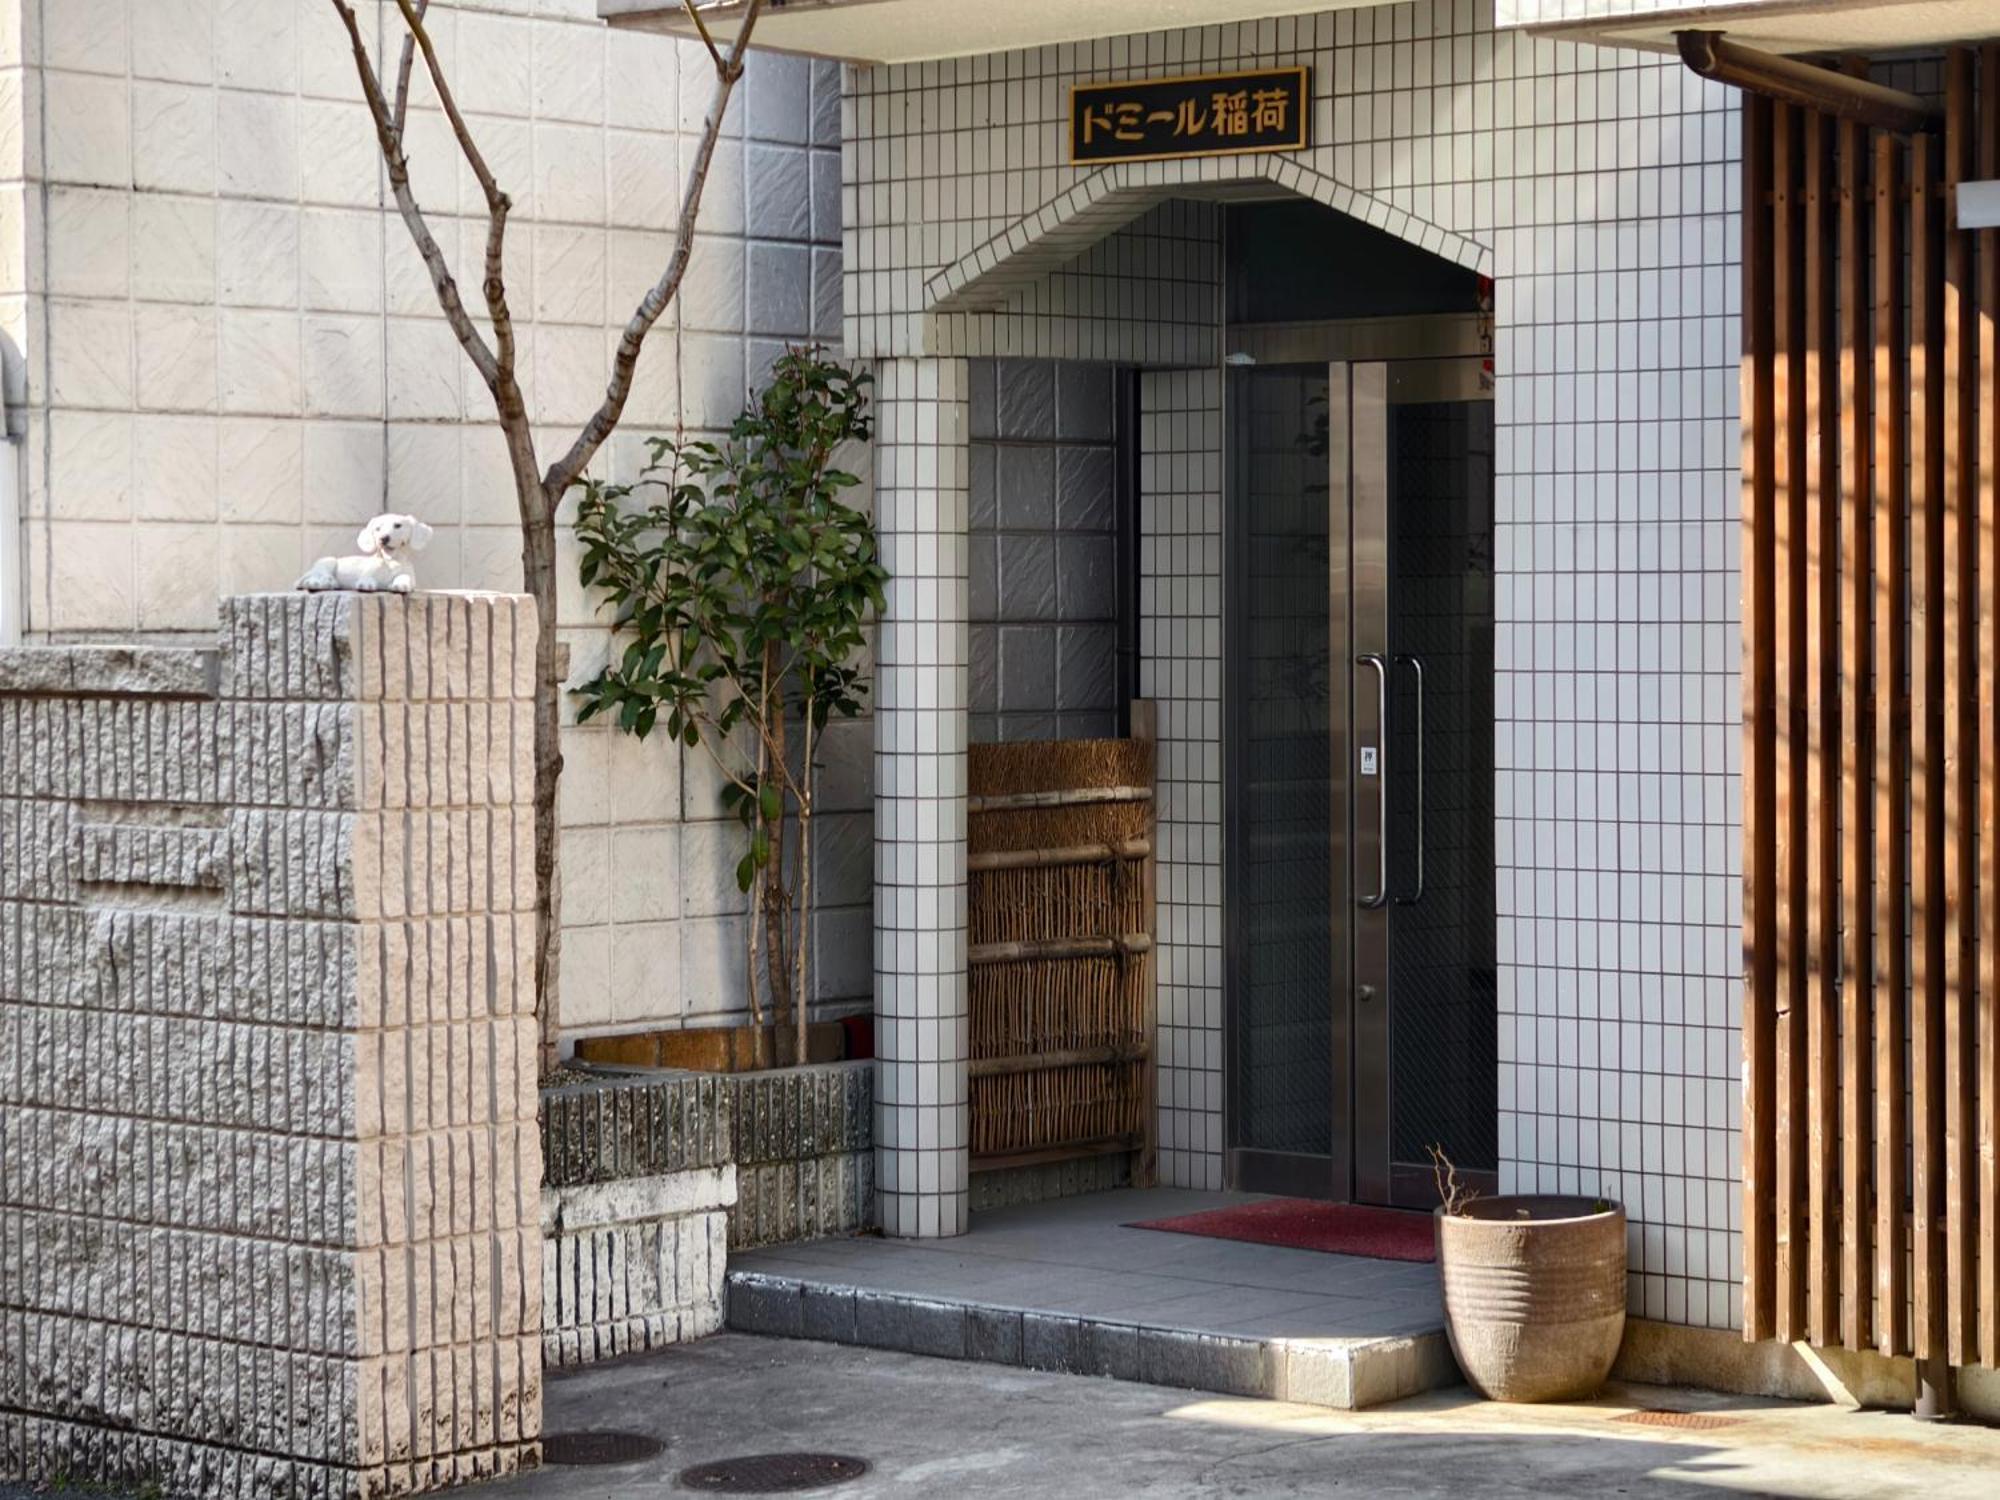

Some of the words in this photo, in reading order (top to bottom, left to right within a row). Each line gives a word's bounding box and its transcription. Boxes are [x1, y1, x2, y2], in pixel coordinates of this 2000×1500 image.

[1083, 87, 1289, 144] ドミール稲荷
